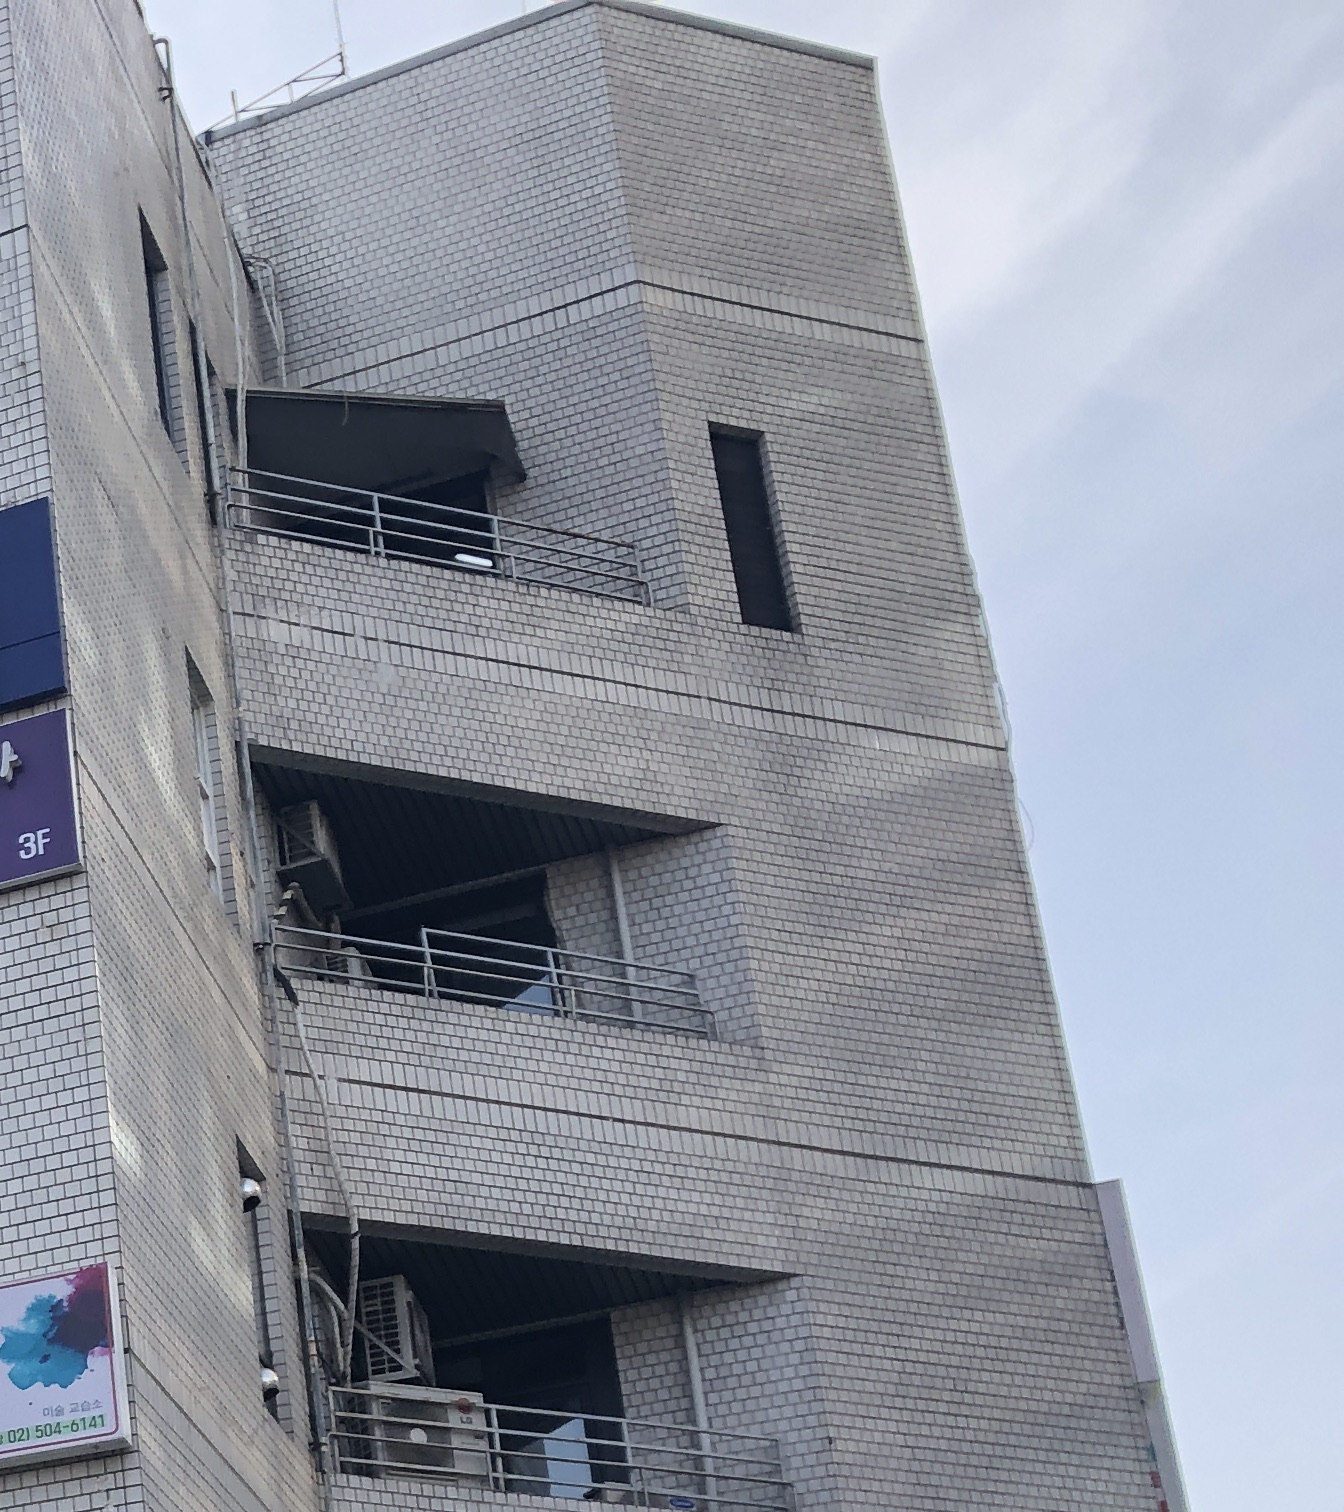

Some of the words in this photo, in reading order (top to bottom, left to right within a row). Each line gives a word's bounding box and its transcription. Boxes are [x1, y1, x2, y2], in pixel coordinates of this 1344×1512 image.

[17, 829, 52, 861] 3F
[42, 1404, 65, 1418] 미술
[69, 1399, 103, 1413] 교습소
[35, 1413, 105, 1439] 504-6141
